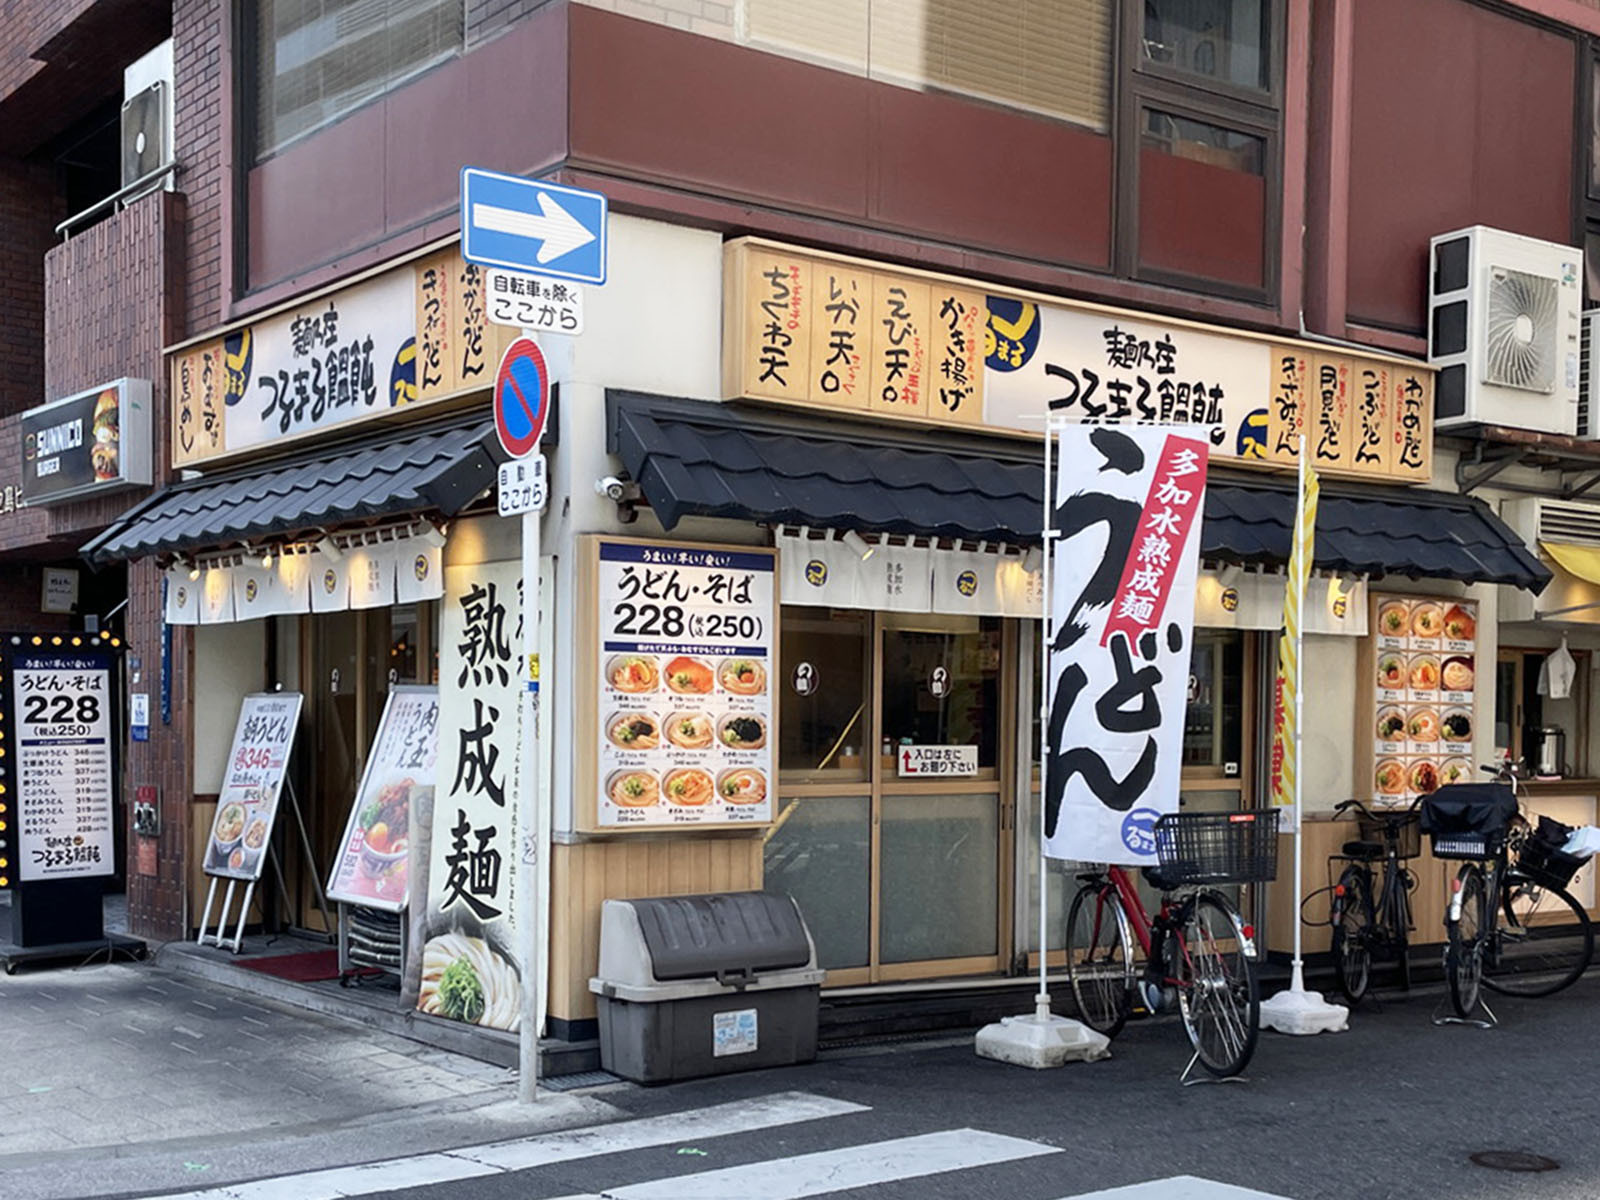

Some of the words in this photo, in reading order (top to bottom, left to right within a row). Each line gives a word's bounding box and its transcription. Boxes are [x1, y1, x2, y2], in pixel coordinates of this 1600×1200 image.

[494, 275, 578, 305] 自転車を除く
[494, 298, 578, 331] ここから
[760, 265, 792, 387] ちくわ天
[939, 296, 974, 412] かき揚げ
[501, 483, 543, 512] ここから
[1116, 445, 1202, 626] 多加水熟成麺
[617, 565, 756, 604] うどん・そば
[613, 603, 685, 637] 228
[21, 674, 102, 692] うどん・そば
[24, 695, 100, 724] 228
[440, 581, 511, 922] 熟成麺
[914, 748, 962, 760] 入口は左に
